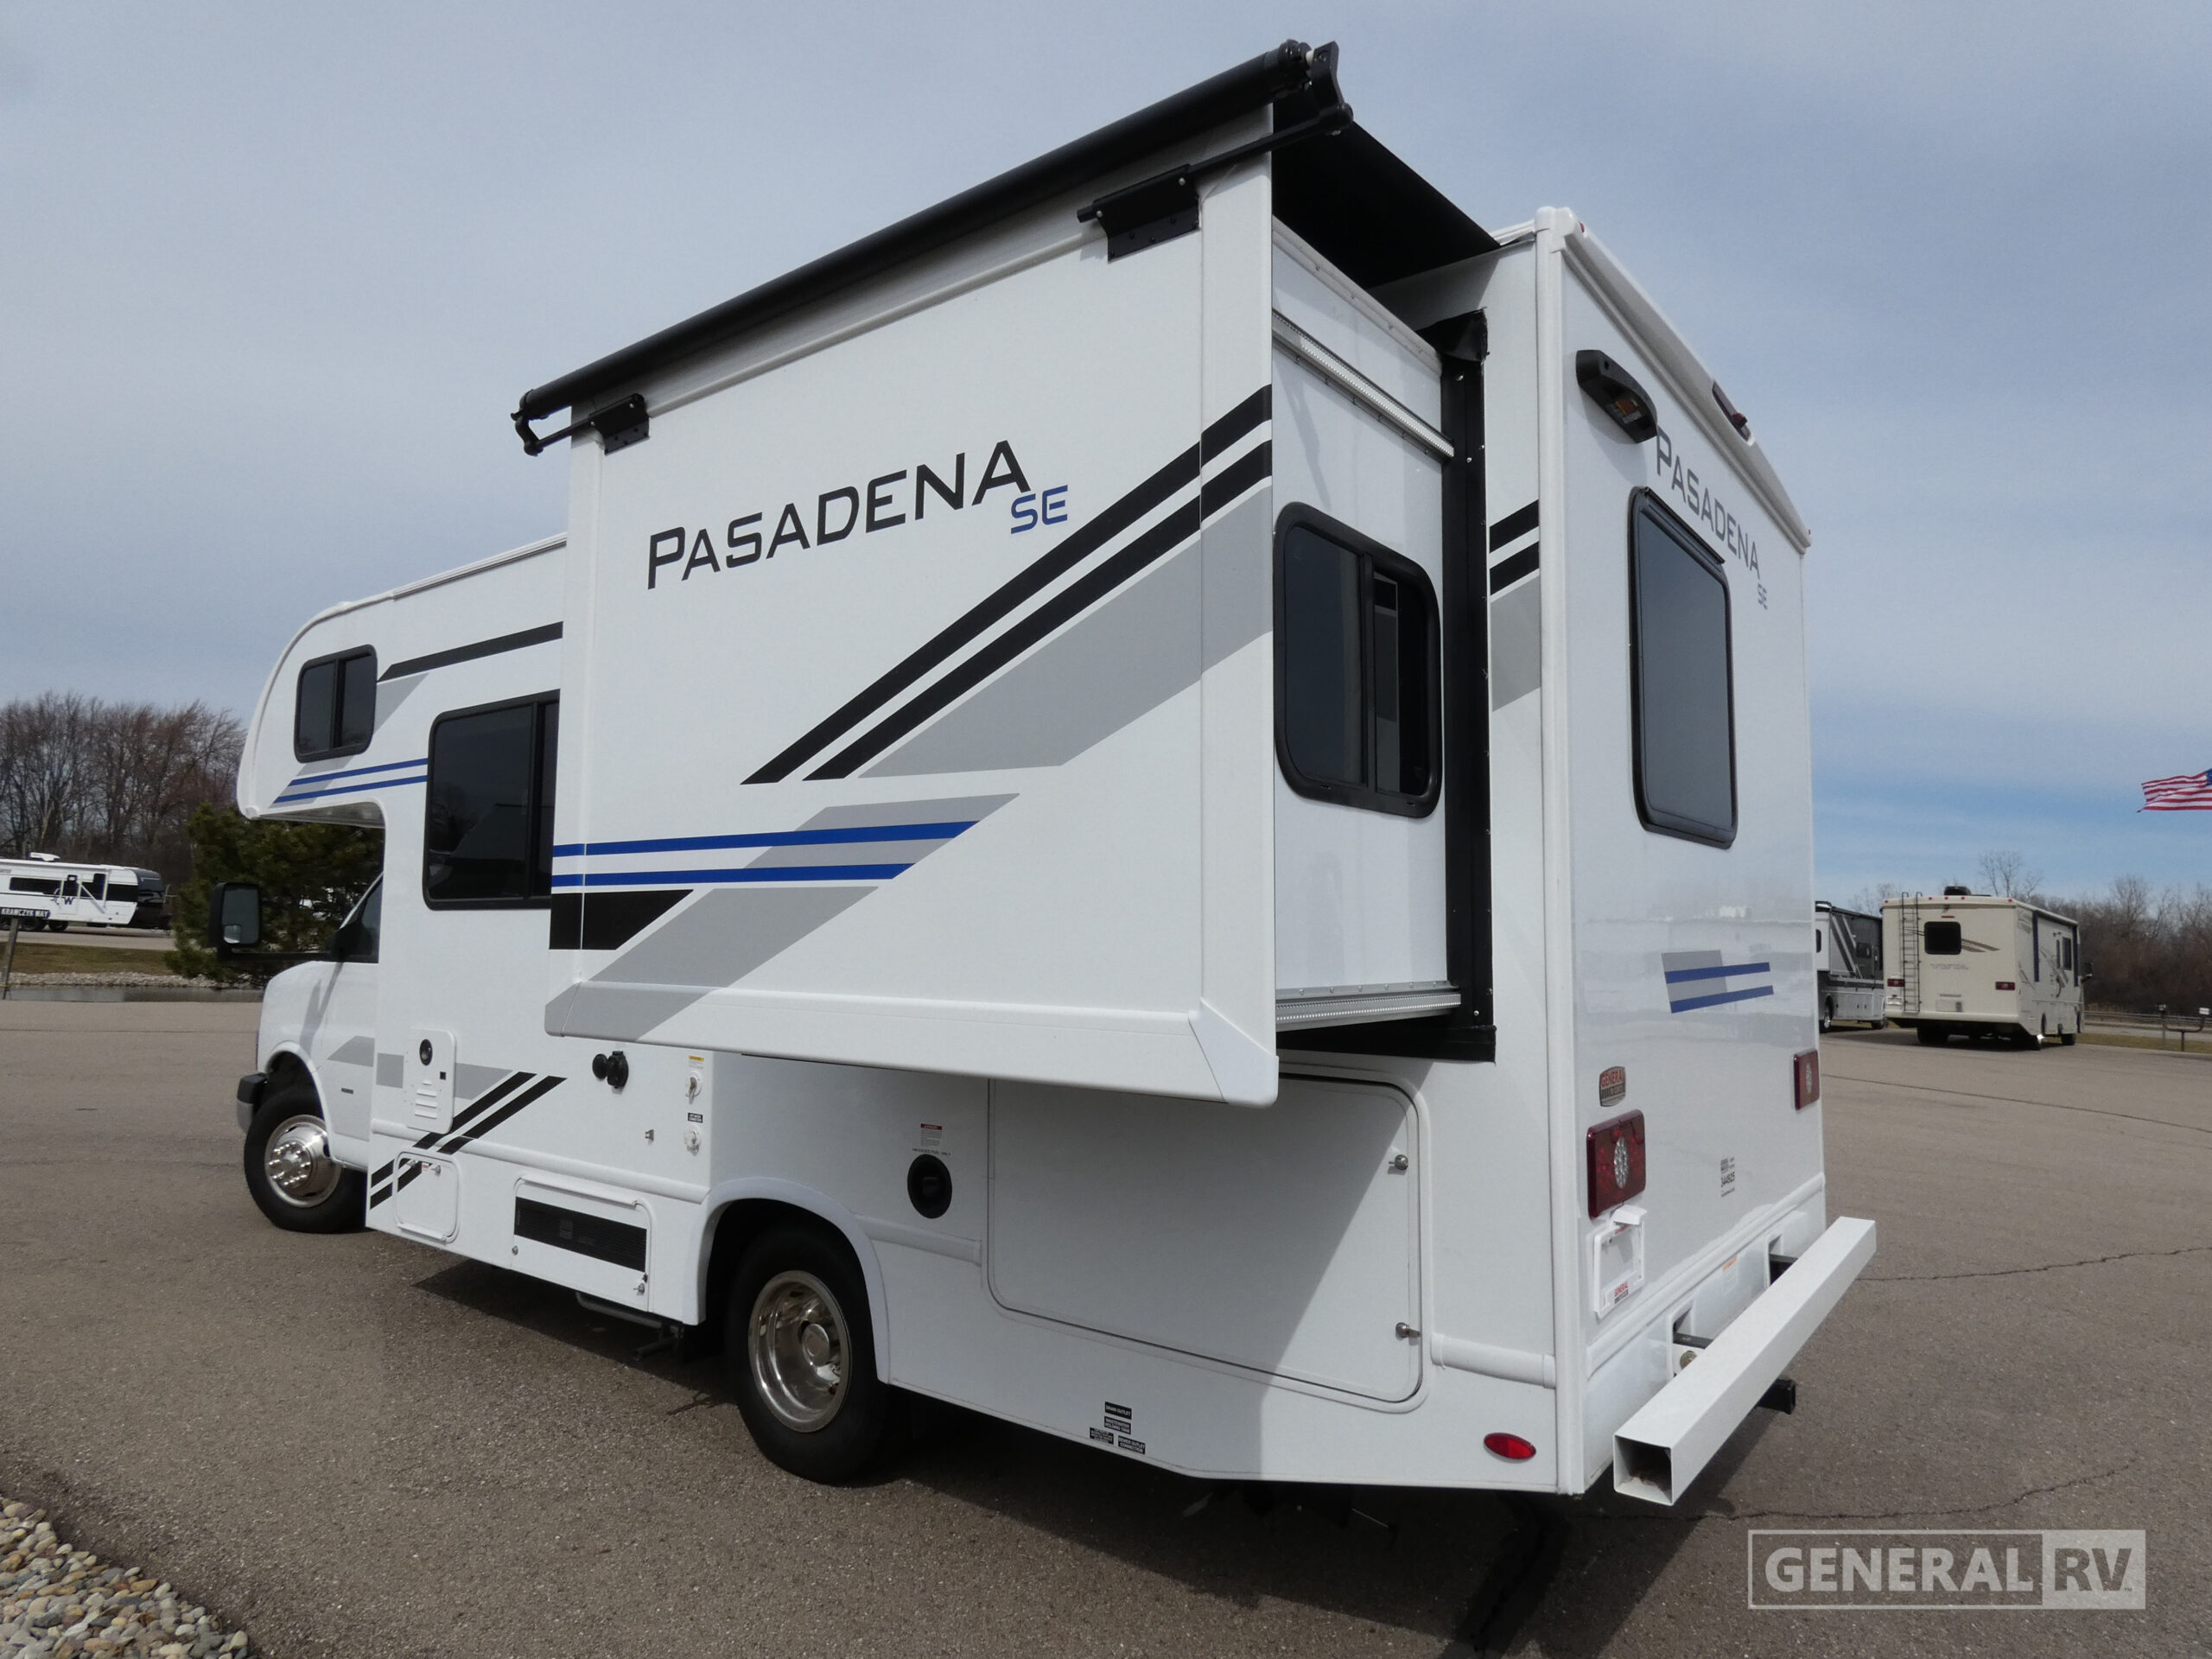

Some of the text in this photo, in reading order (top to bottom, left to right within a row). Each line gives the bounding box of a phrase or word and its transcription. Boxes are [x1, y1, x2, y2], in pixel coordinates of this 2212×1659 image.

[647, 439, 1032, 590] PASADENA
[1009, 484, 1069, 535] SE
[1656, 425, 1761, 581] PASADENA
[1757, 582, 1769, 611] SE
